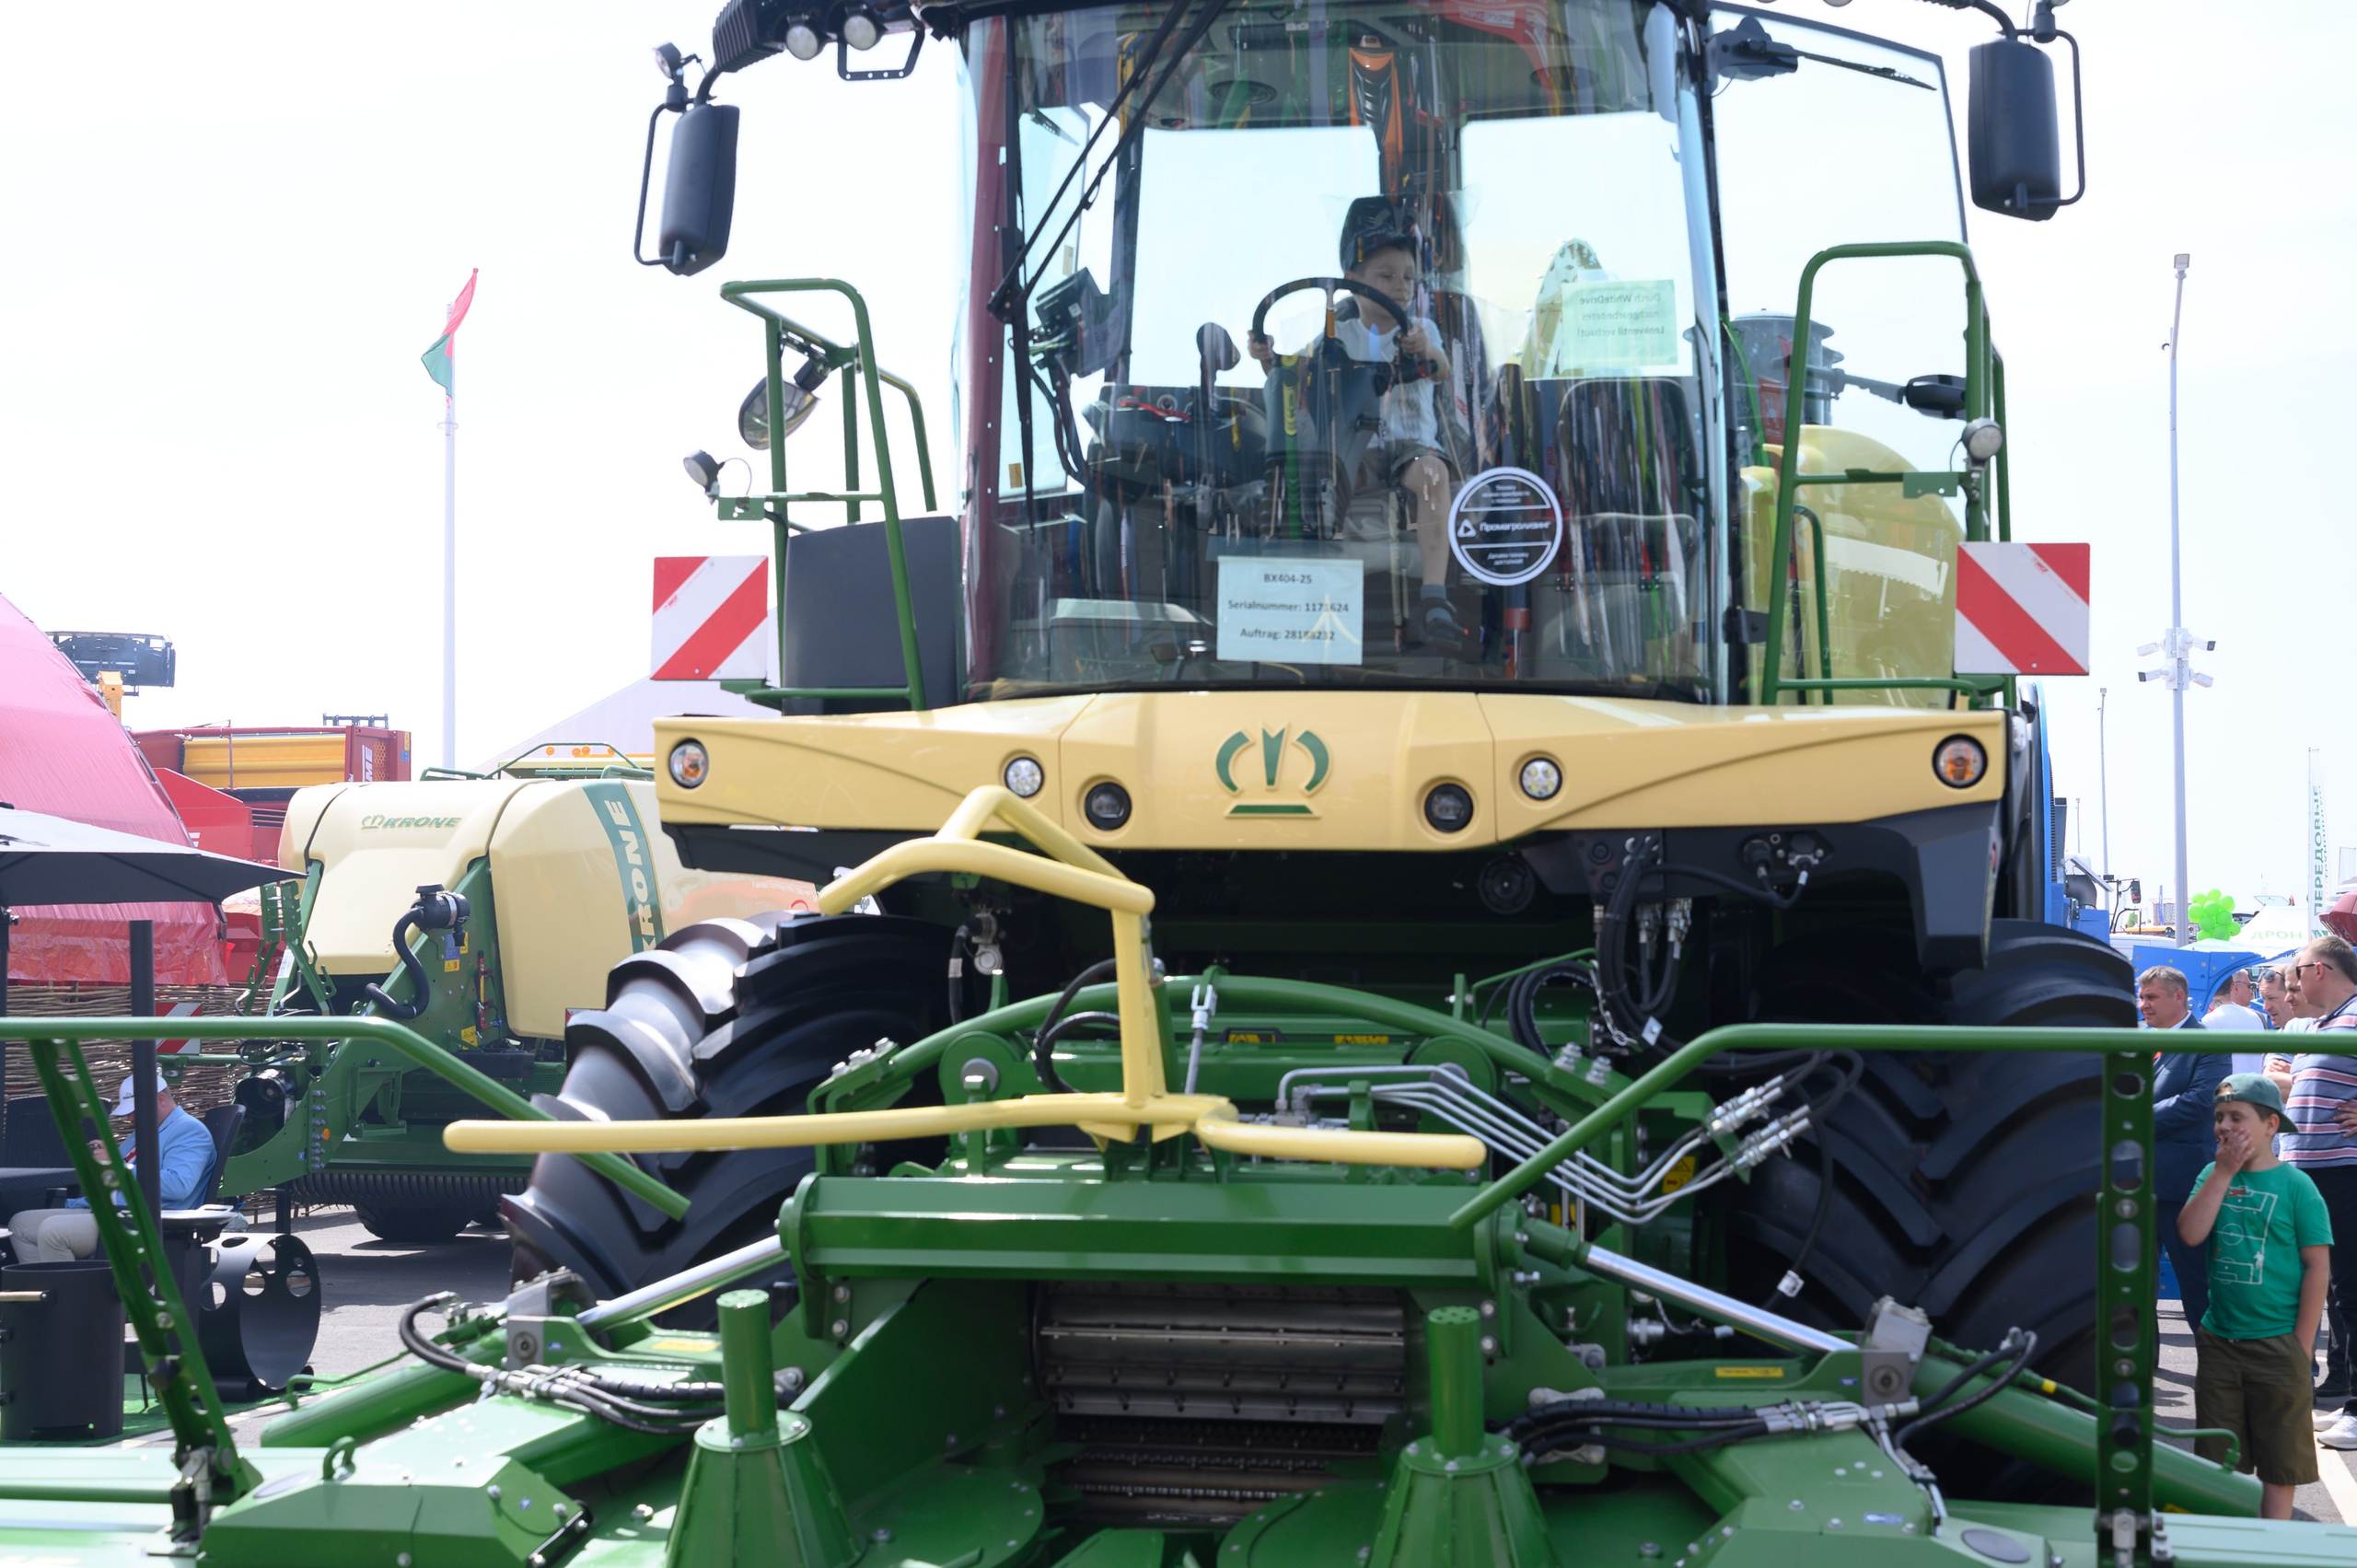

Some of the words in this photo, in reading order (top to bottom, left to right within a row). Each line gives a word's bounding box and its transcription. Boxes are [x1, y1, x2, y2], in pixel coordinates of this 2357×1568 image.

[1263, 574, 1313, 585] BX404-25
[1227, 599, 1302, 612] Serialnummer:
[1239, 628, 1282, 641] Auftrag:
[382, 816, 462, 829] KRONE
